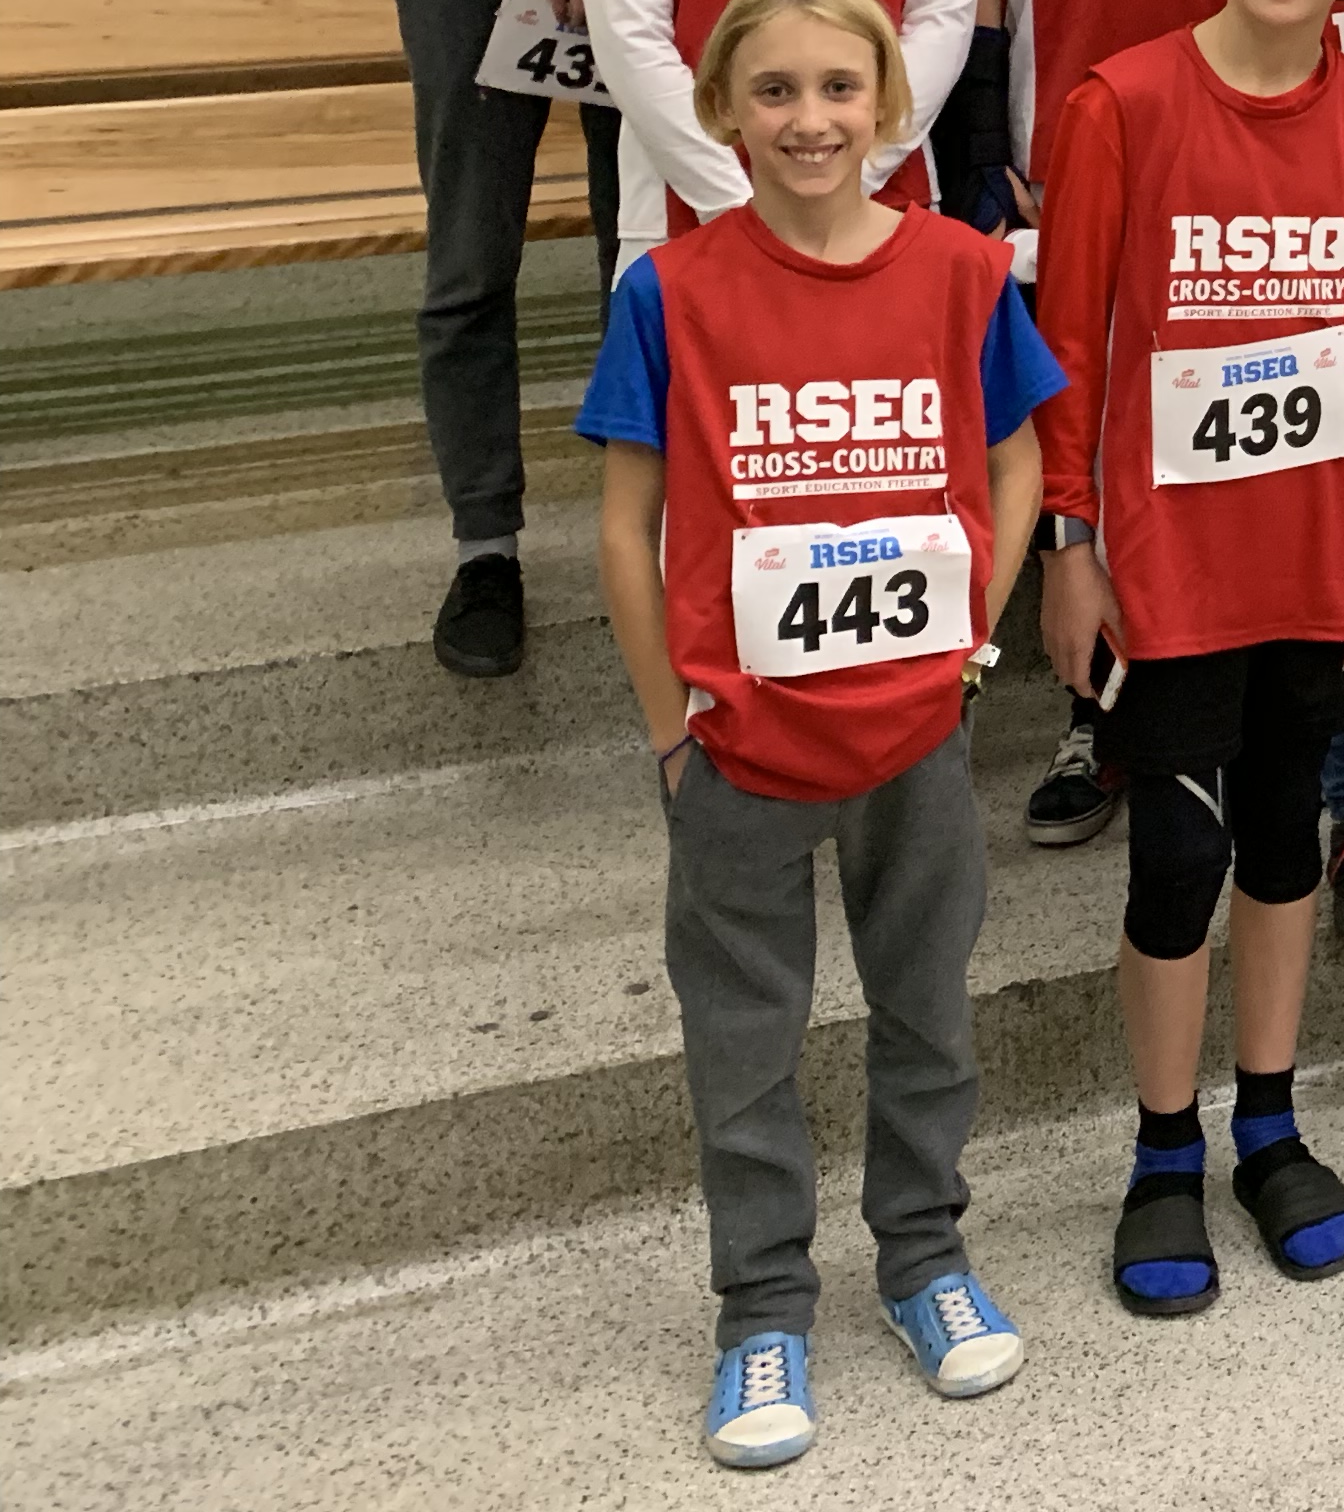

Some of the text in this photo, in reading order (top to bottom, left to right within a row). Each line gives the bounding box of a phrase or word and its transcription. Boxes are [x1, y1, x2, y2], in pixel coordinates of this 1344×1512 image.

[516, 38, 608, 94] 43
[1221, 355, 1299, 387] RSEQ
[728, 378, 943, 447] RSEQ
[1192, 384, 1321, 463] 439
[730, 444, 947, 479] CROSS-COUNTRY
[810, 536, 904, 570] RSEQ
[777, 569, 930, 654] 443
